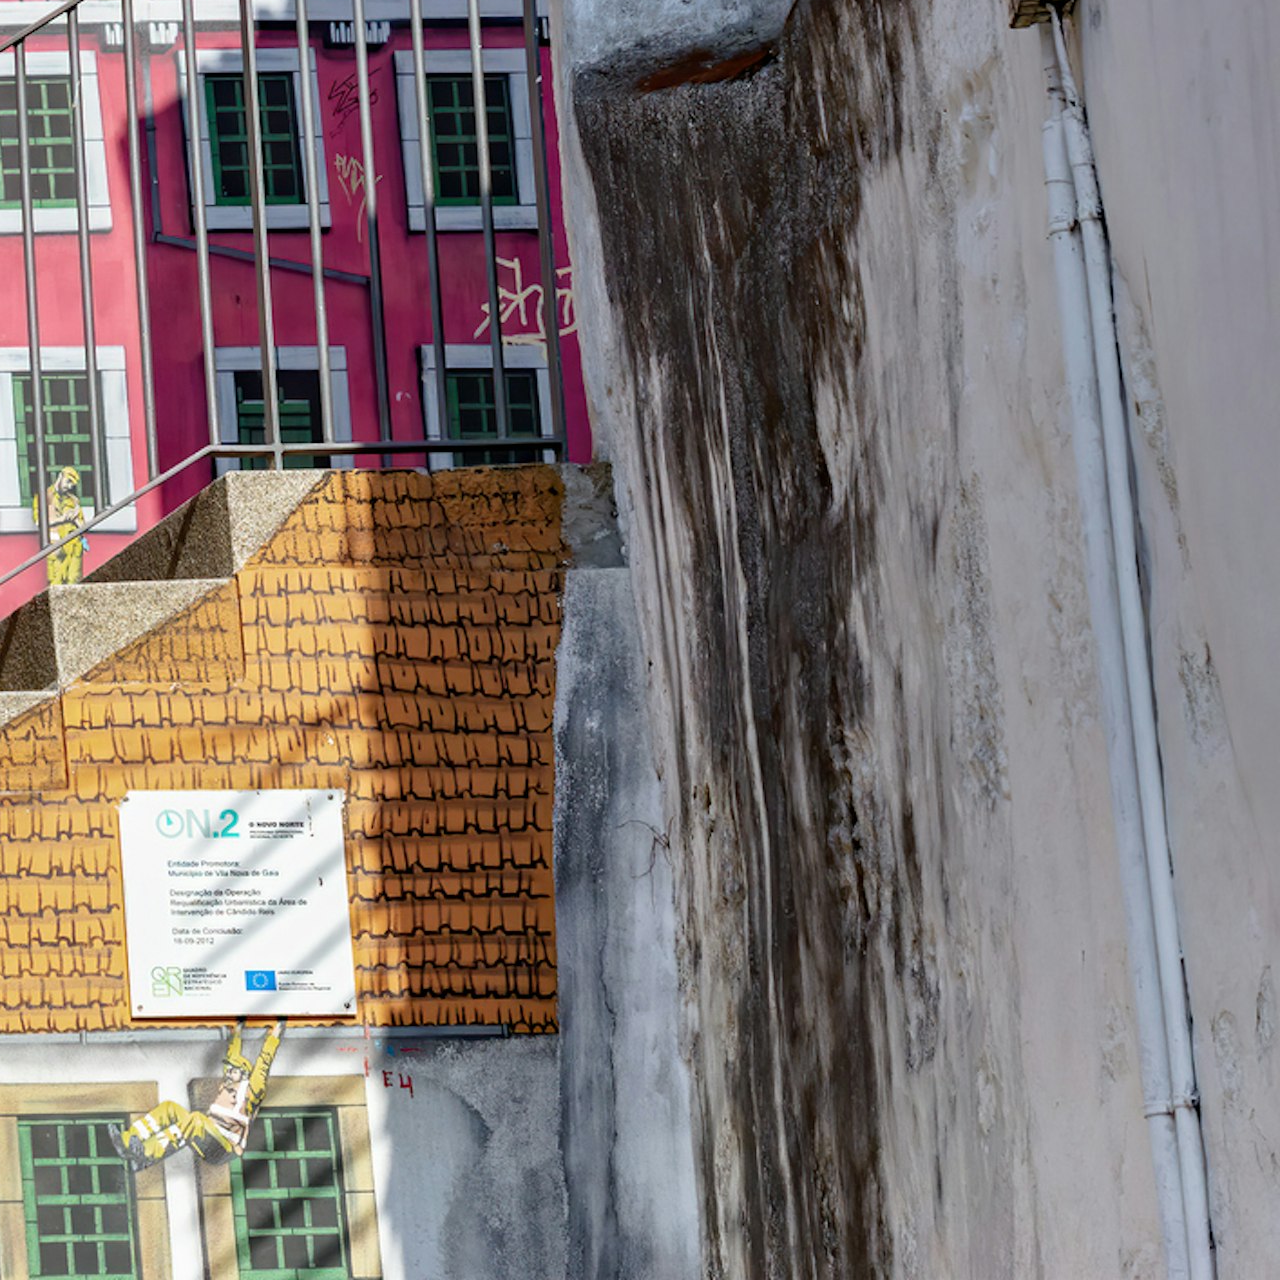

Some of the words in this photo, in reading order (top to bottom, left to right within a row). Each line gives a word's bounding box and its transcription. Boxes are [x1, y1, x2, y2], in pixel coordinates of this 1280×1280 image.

[167, 860, 199, 868] Entidade
[215, 869, 229, 877] Vila
[230, 869, 249, 877] Nova
[251, 869, 260, 877] de
[262, 869, 279, 877] Gaia
[278, 897, 296, 905] Área
